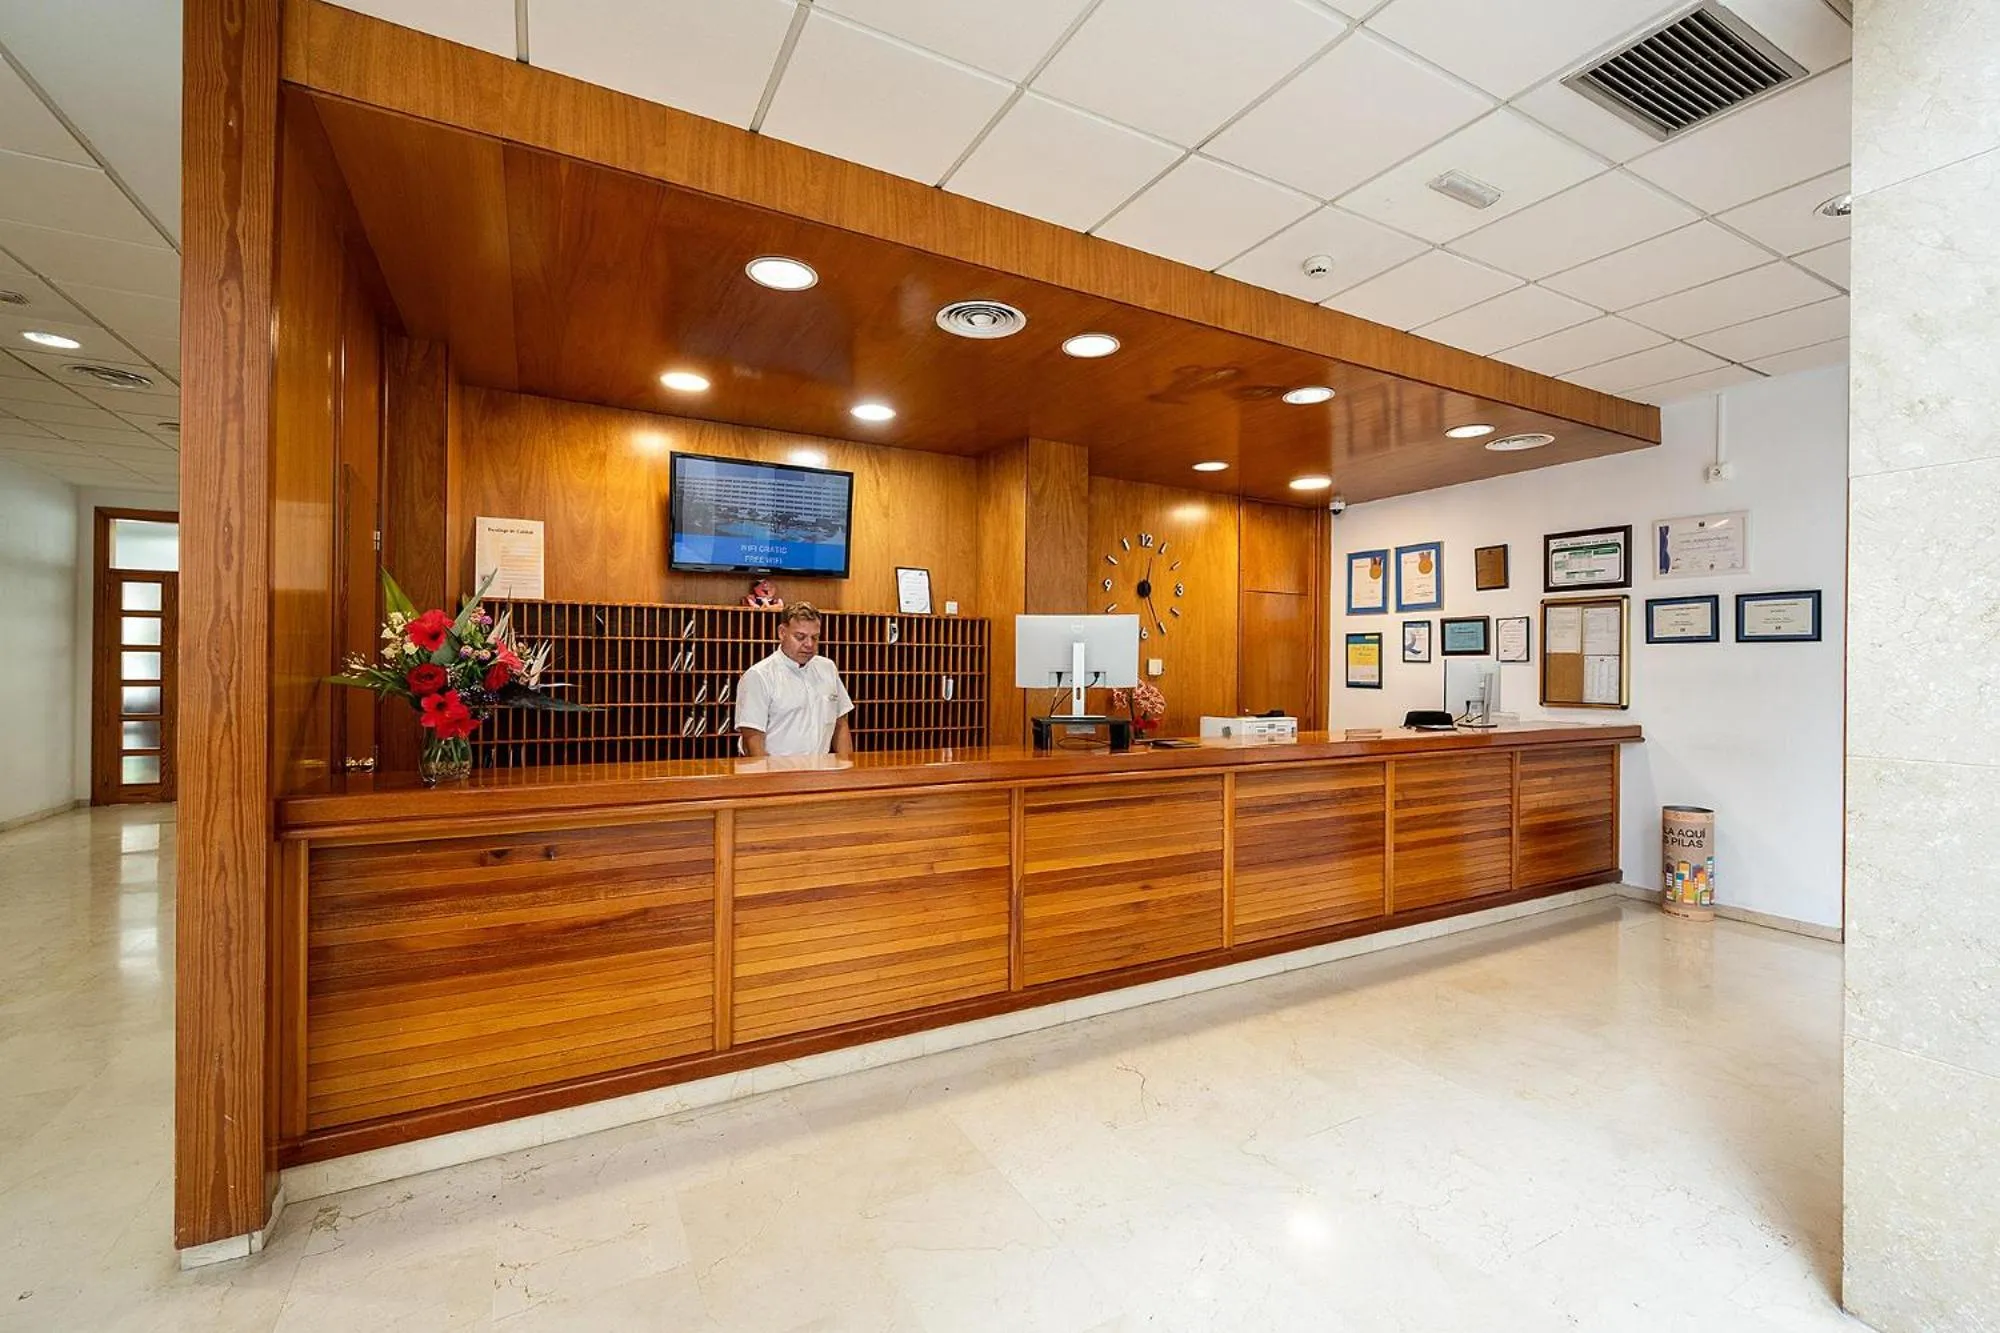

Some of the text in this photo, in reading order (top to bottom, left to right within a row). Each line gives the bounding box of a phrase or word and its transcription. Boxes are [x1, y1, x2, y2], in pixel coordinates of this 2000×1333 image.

[1140, 533, 1153, 548] 12
[744, 555, 765, 564] FREE
[1104, 578, 1113, 591] 9
[1176, 584, 1184, 597] 3
[1140, 627, 1149, 640] 6
[1671, 837, 1704, 848] PILAS
